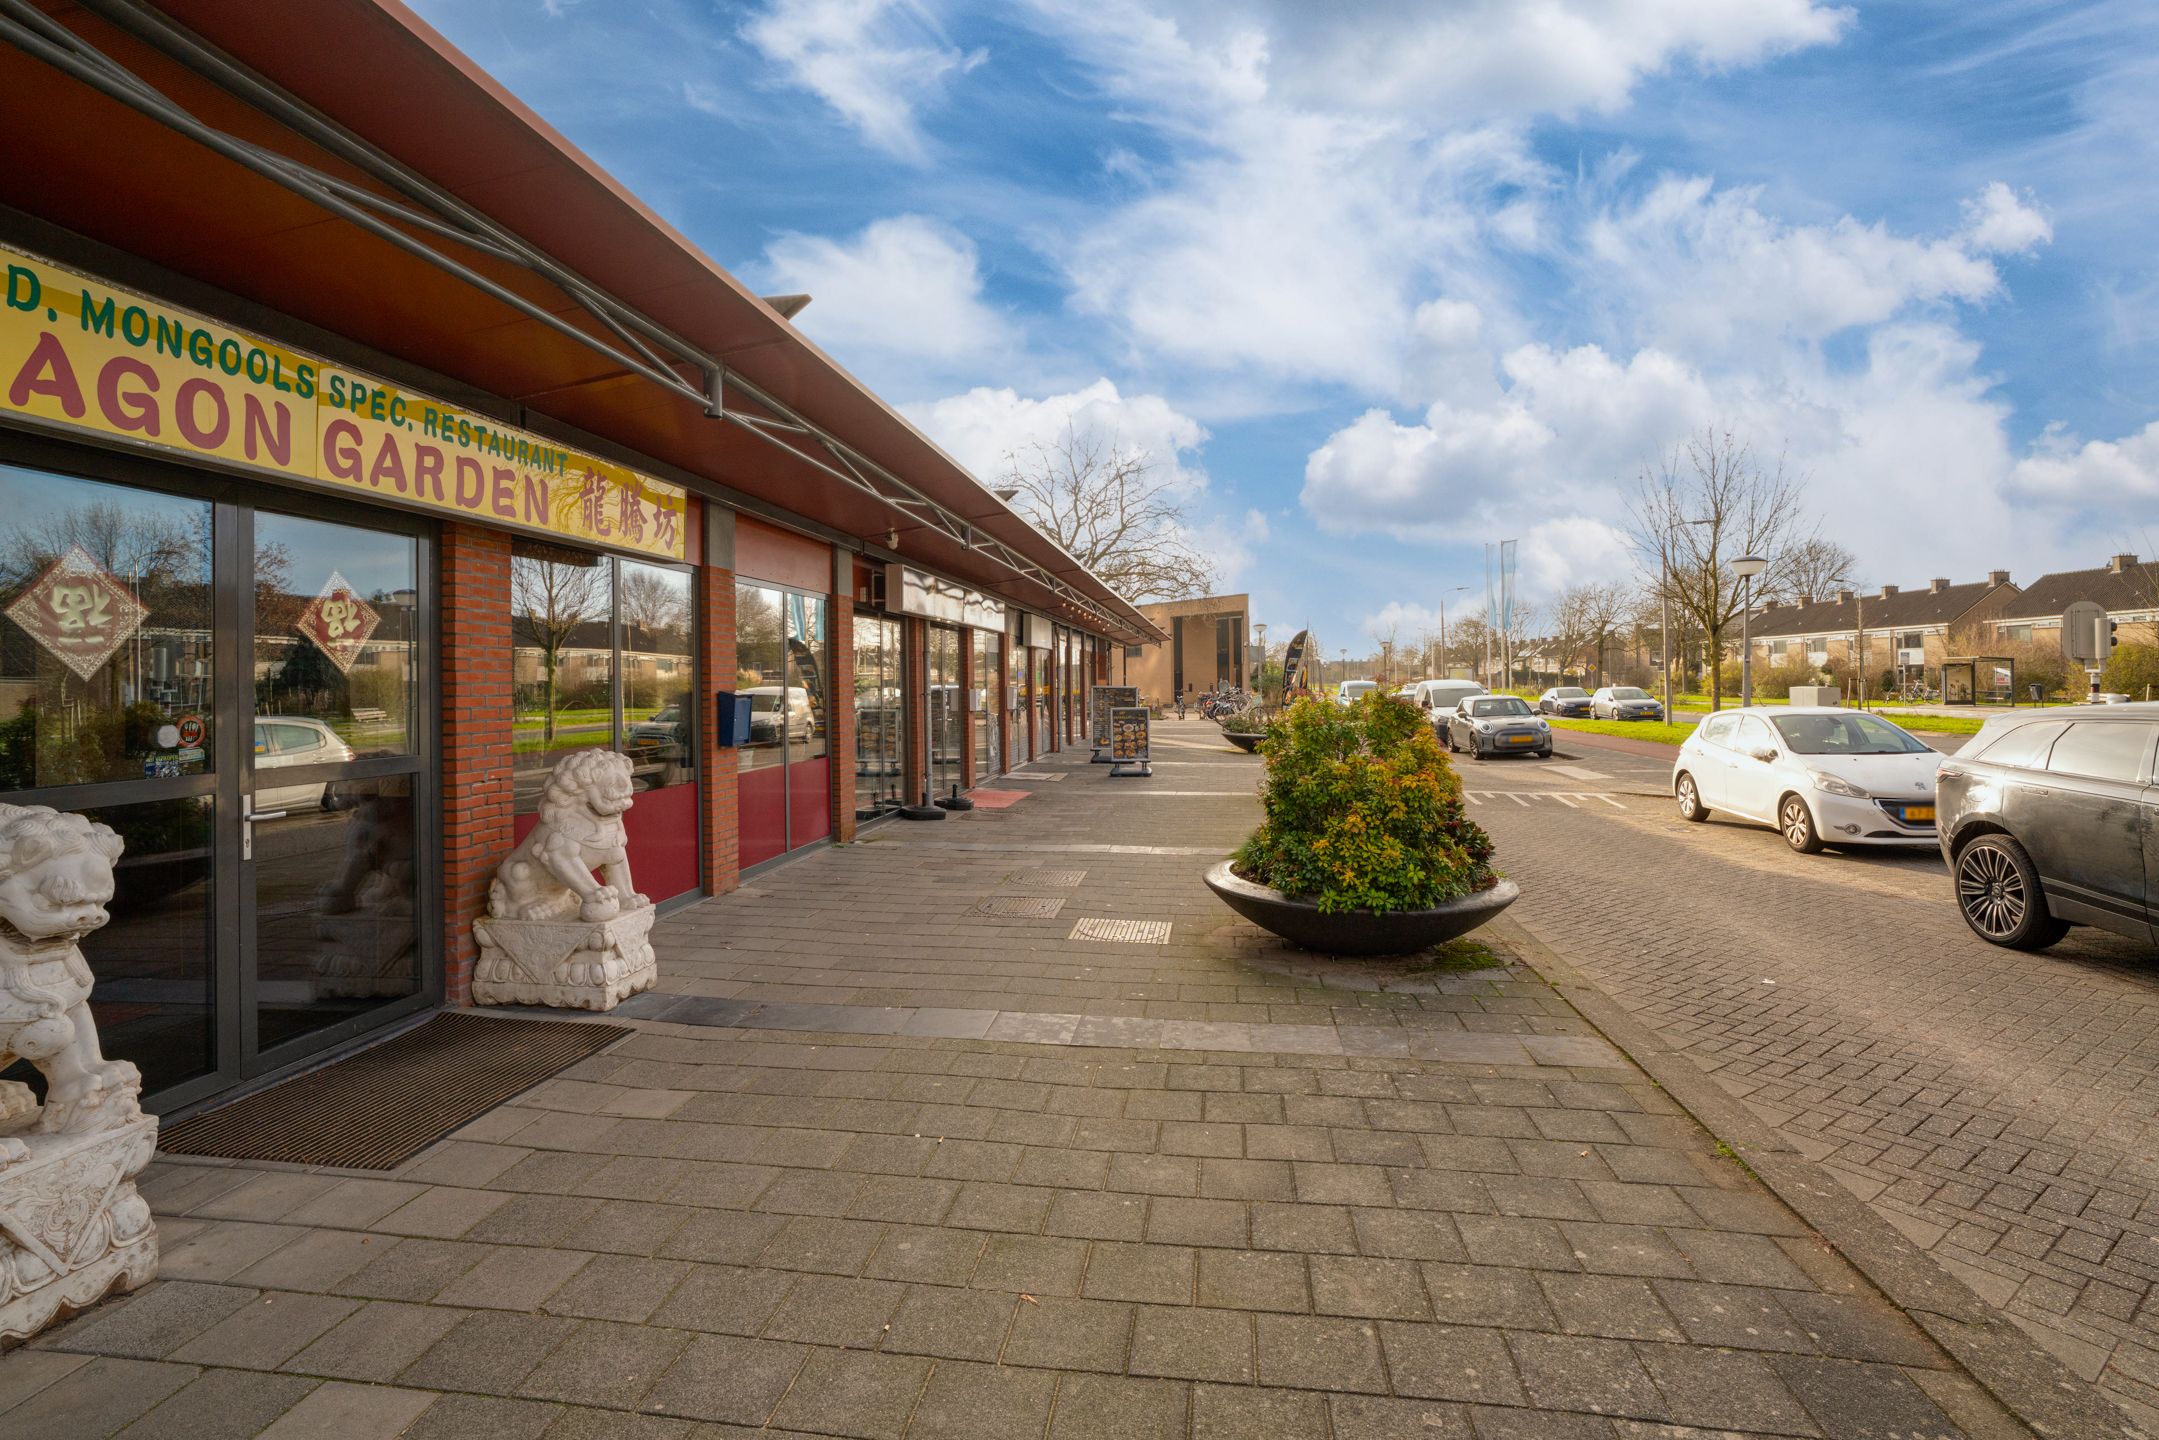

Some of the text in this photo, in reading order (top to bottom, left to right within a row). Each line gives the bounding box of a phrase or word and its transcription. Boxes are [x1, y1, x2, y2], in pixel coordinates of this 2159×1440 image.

[9, 332, 548, 525] AGON GARDEN
[81, 289, 315, 399] MONGOOLS
[329, 375, 412, 432] SPEC.
[424, 407, 567, 477] RESTAURANT
